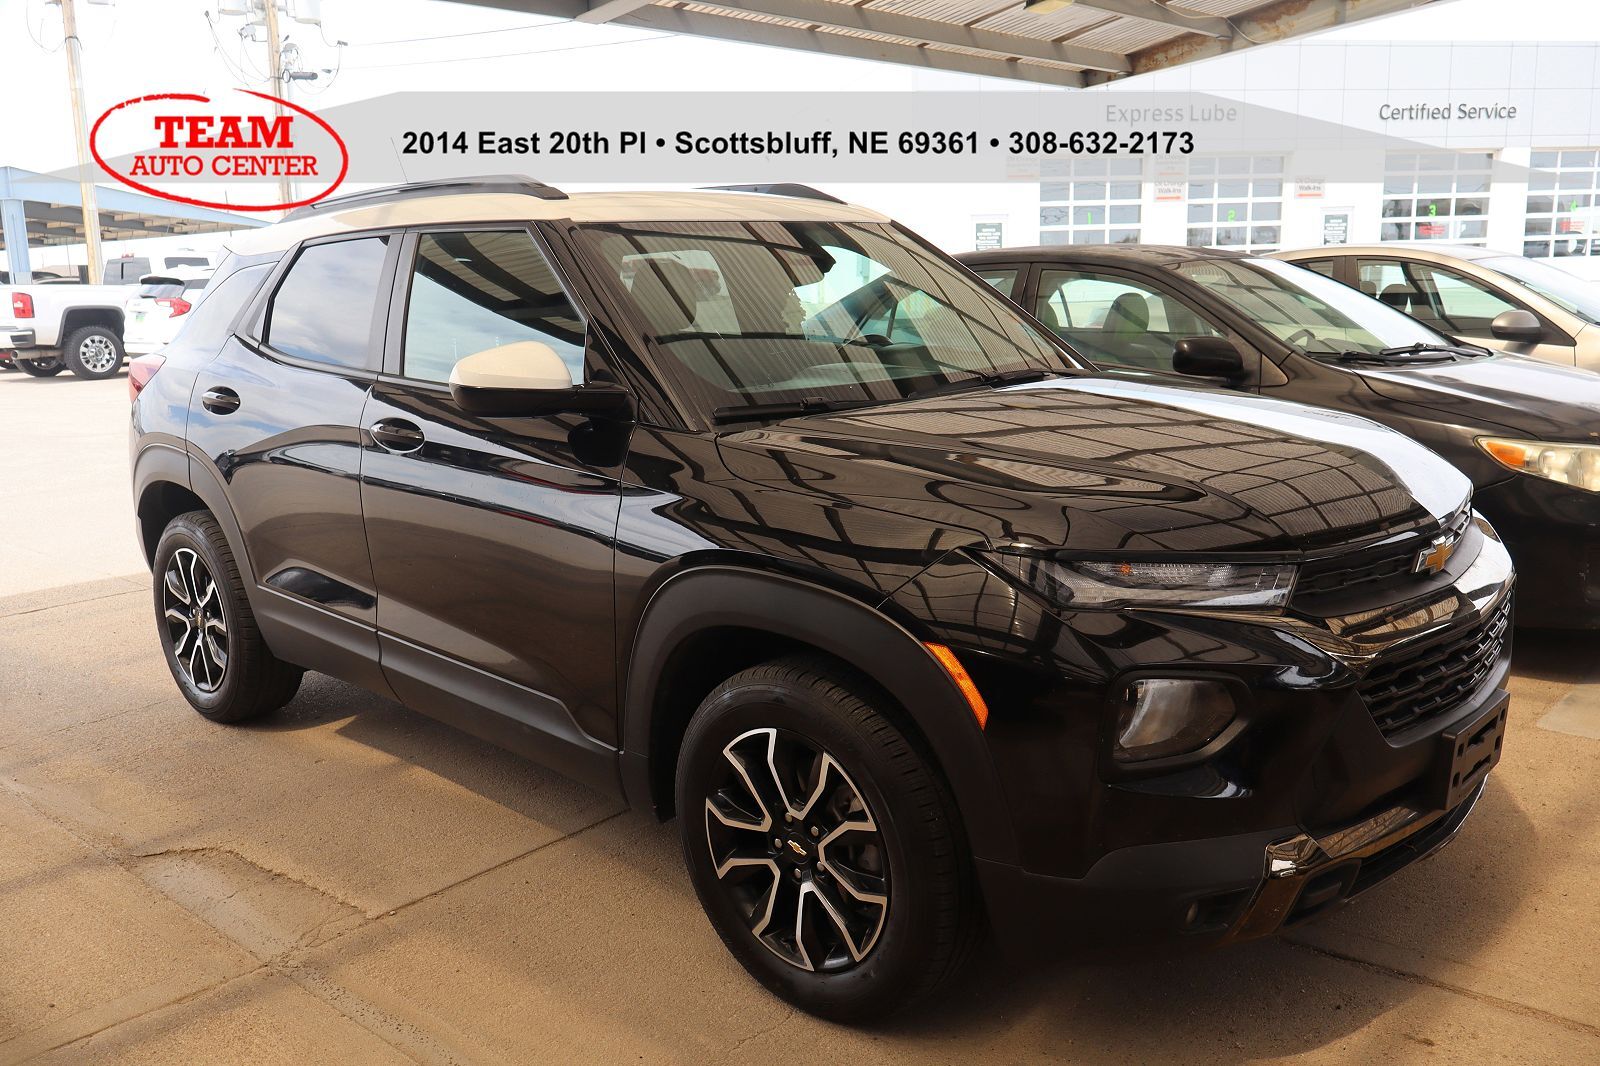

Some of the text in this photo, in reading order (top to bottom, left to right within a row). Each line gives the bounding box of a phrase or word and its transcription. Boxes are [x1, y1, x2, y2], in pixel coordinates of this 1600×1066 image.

[1106, 103, 1237, 127] Express Lube
[1379, 103, 1517, 120] Certified Service
[1428, 203, 1438, 217] 3
